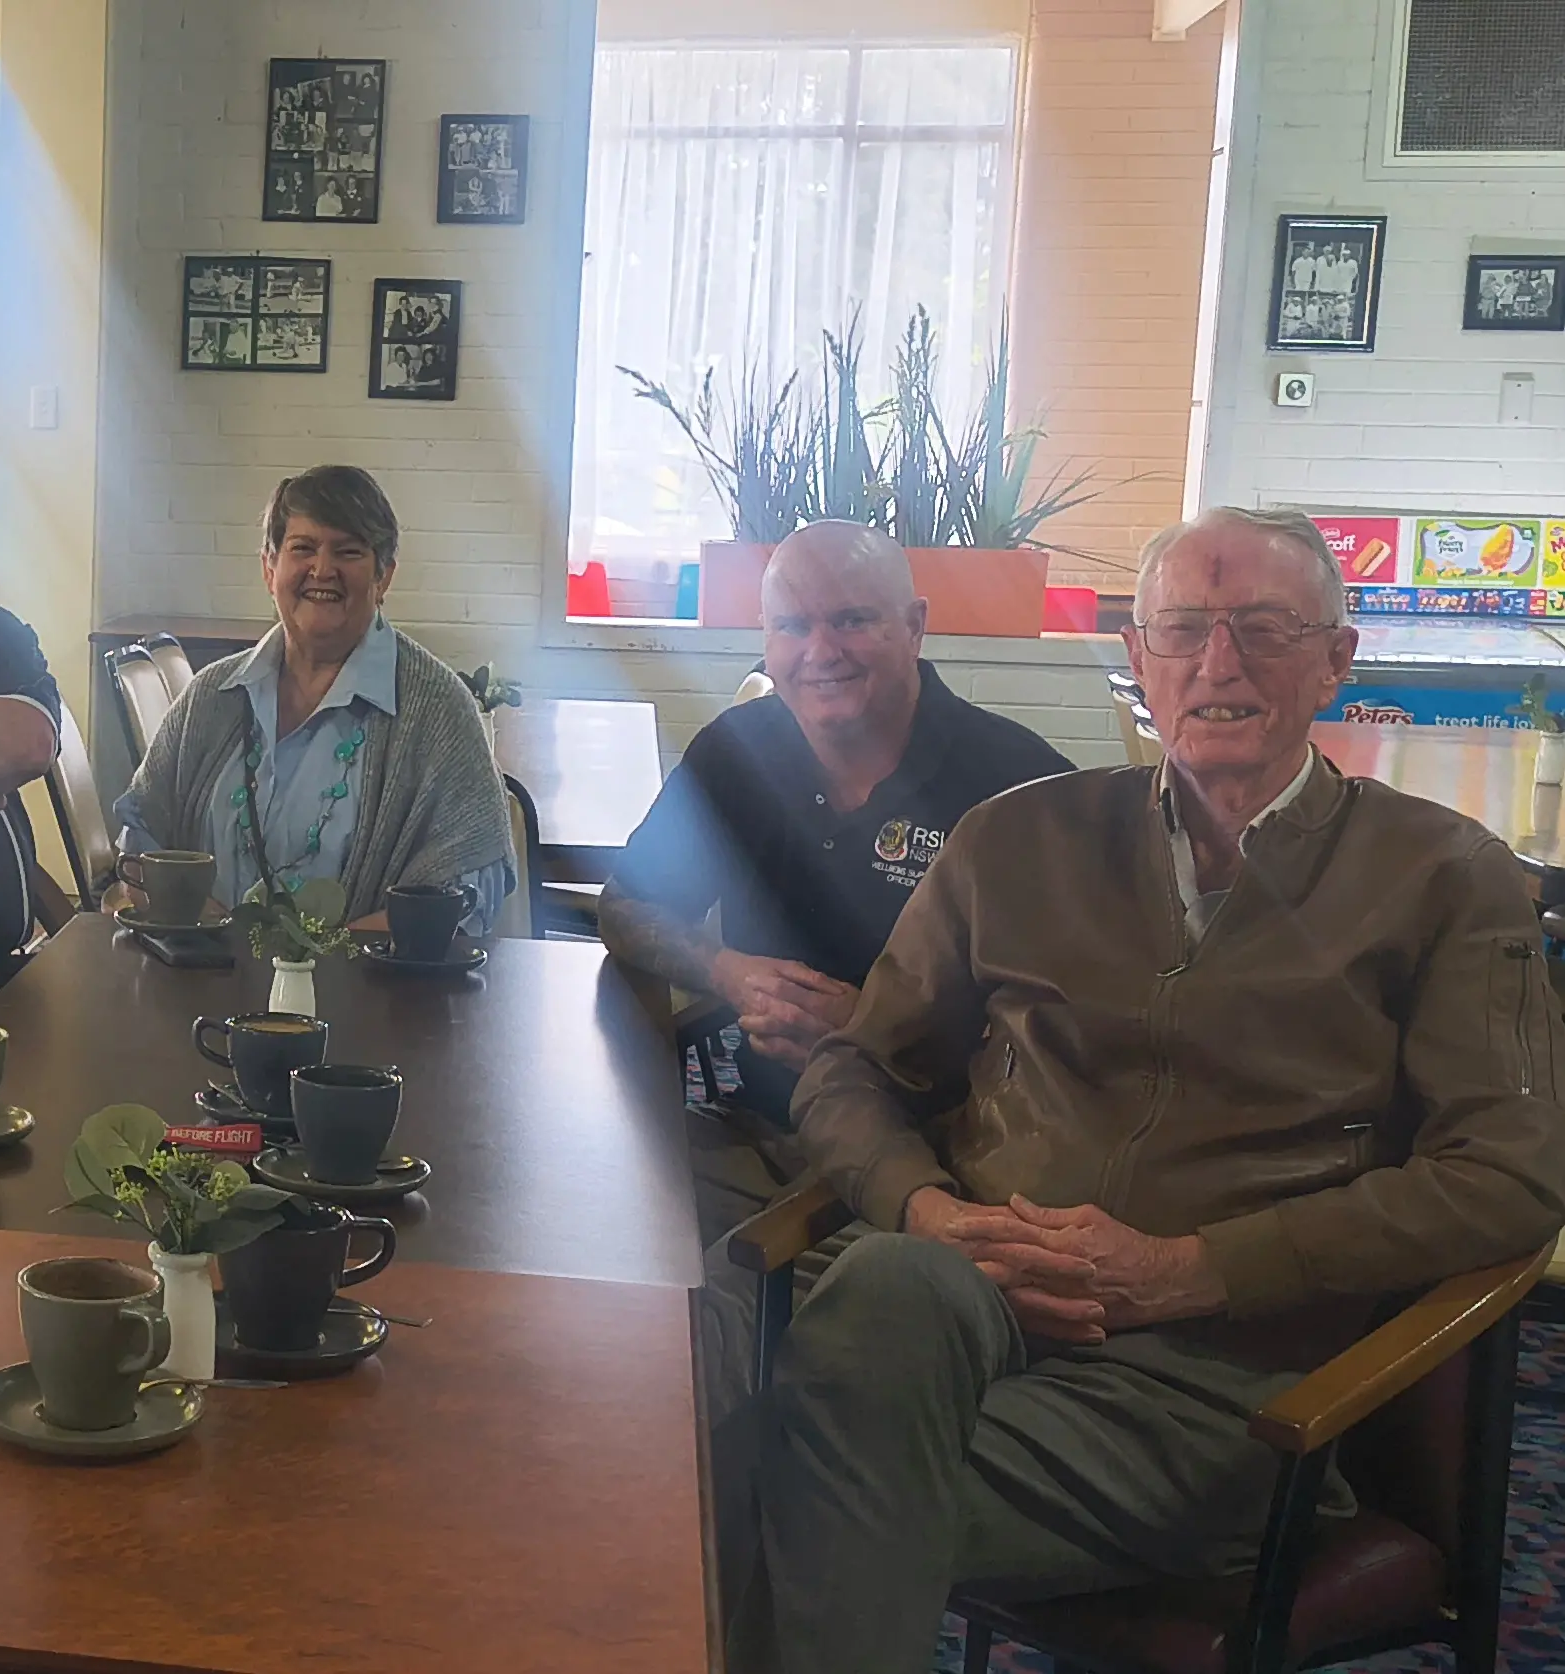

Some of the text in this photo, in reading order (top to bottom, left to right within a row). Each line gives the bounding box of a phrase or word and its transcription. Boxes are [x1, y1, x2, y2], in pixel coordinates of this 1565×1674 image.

[1342, 703, 1414, 725] Peters
[1435, 714, 1479, 728] treat
[1483, 715, 1509, 729] life
[171, 1128, 255, 1144] BEFORE FLIGHT
